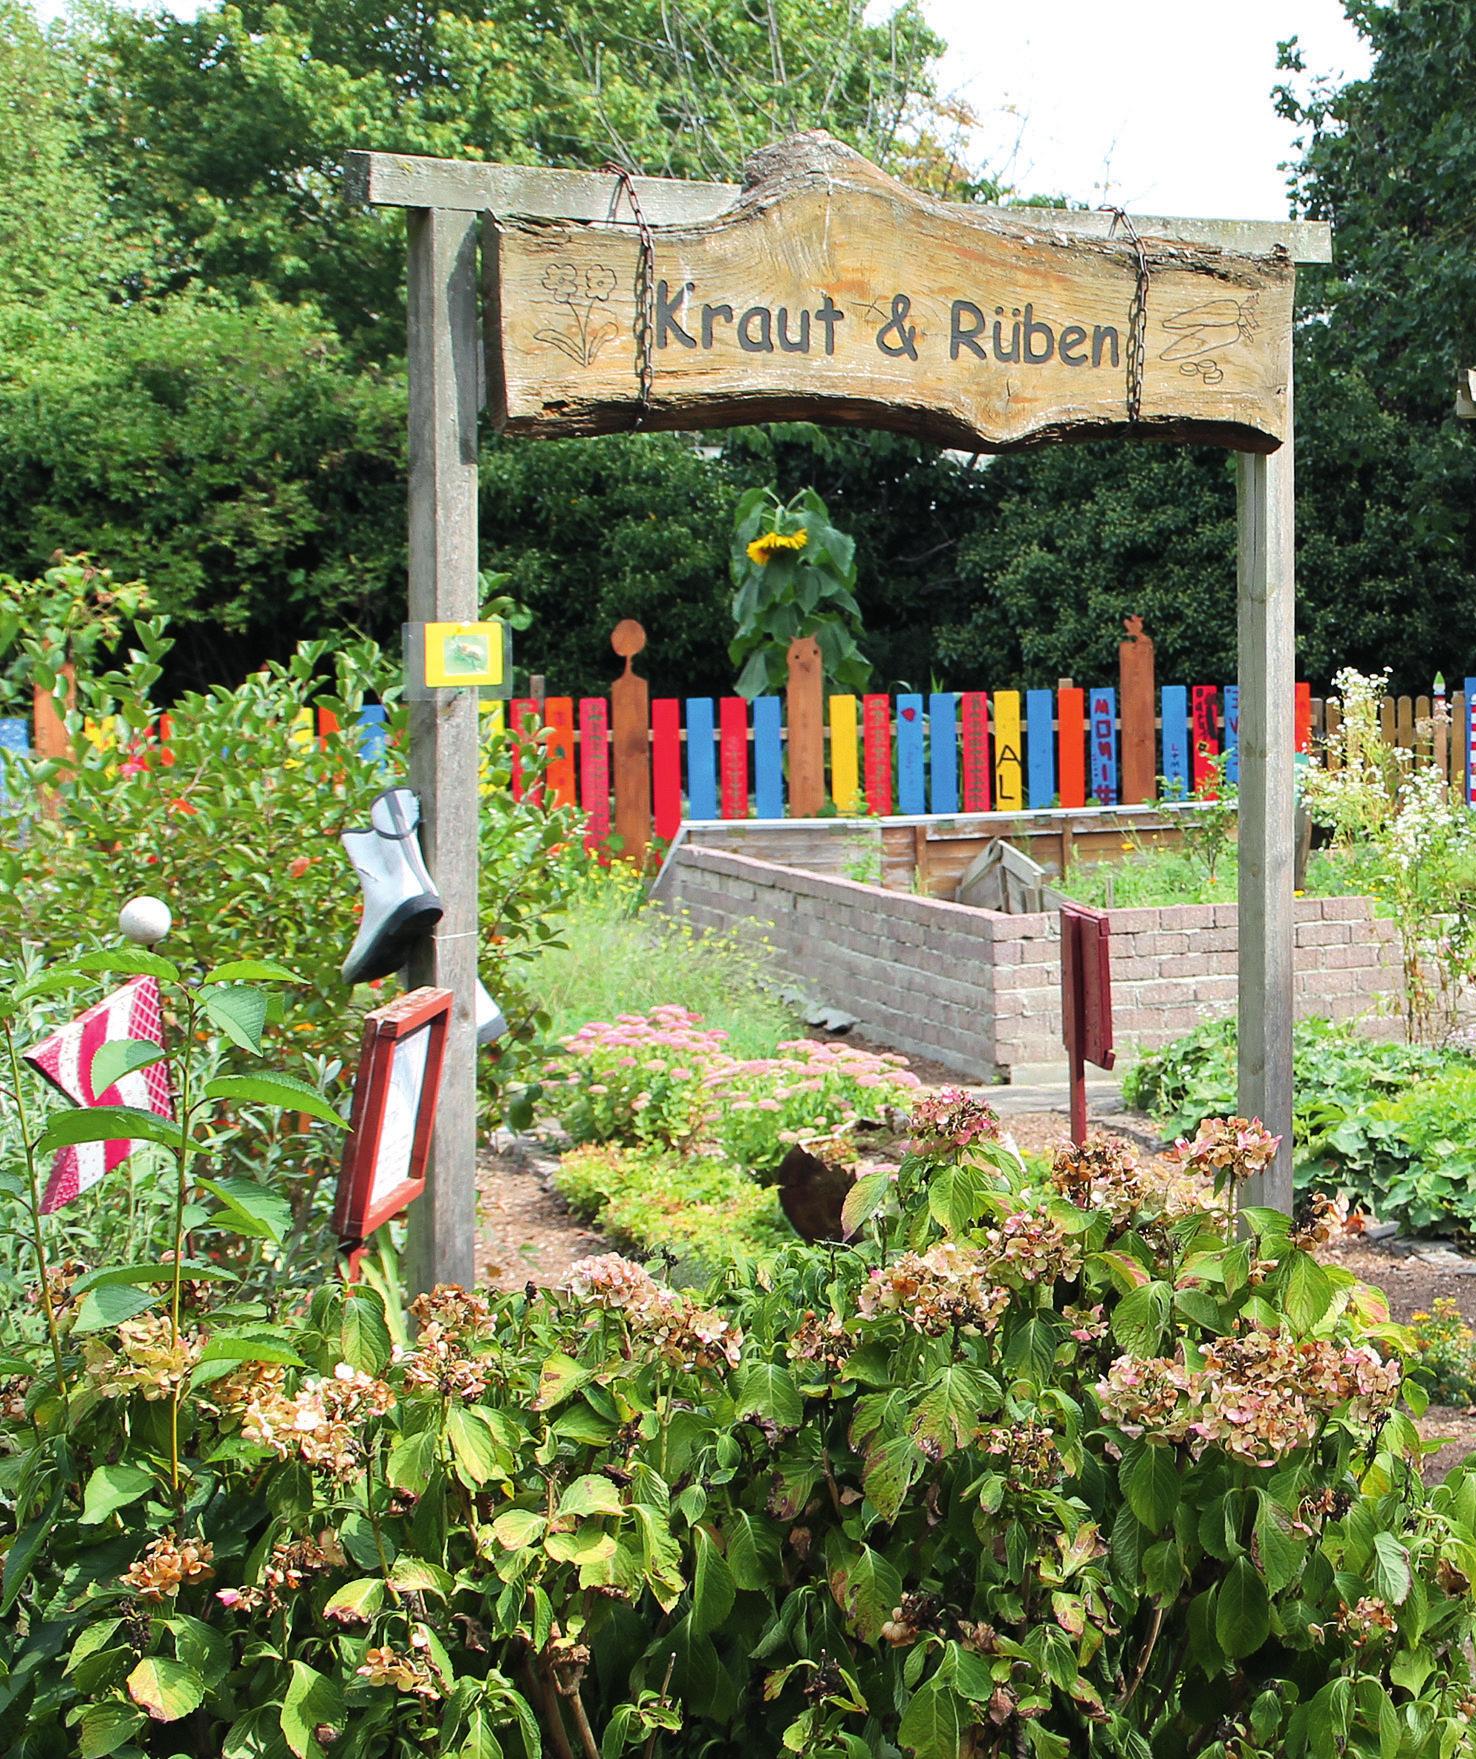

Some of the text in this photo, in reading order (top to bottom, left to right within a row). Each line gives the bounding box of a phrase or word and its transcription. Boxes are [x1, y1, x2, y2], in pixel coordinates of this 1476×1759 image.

[656, 279, 1119, 368] Kraut & Rüben
